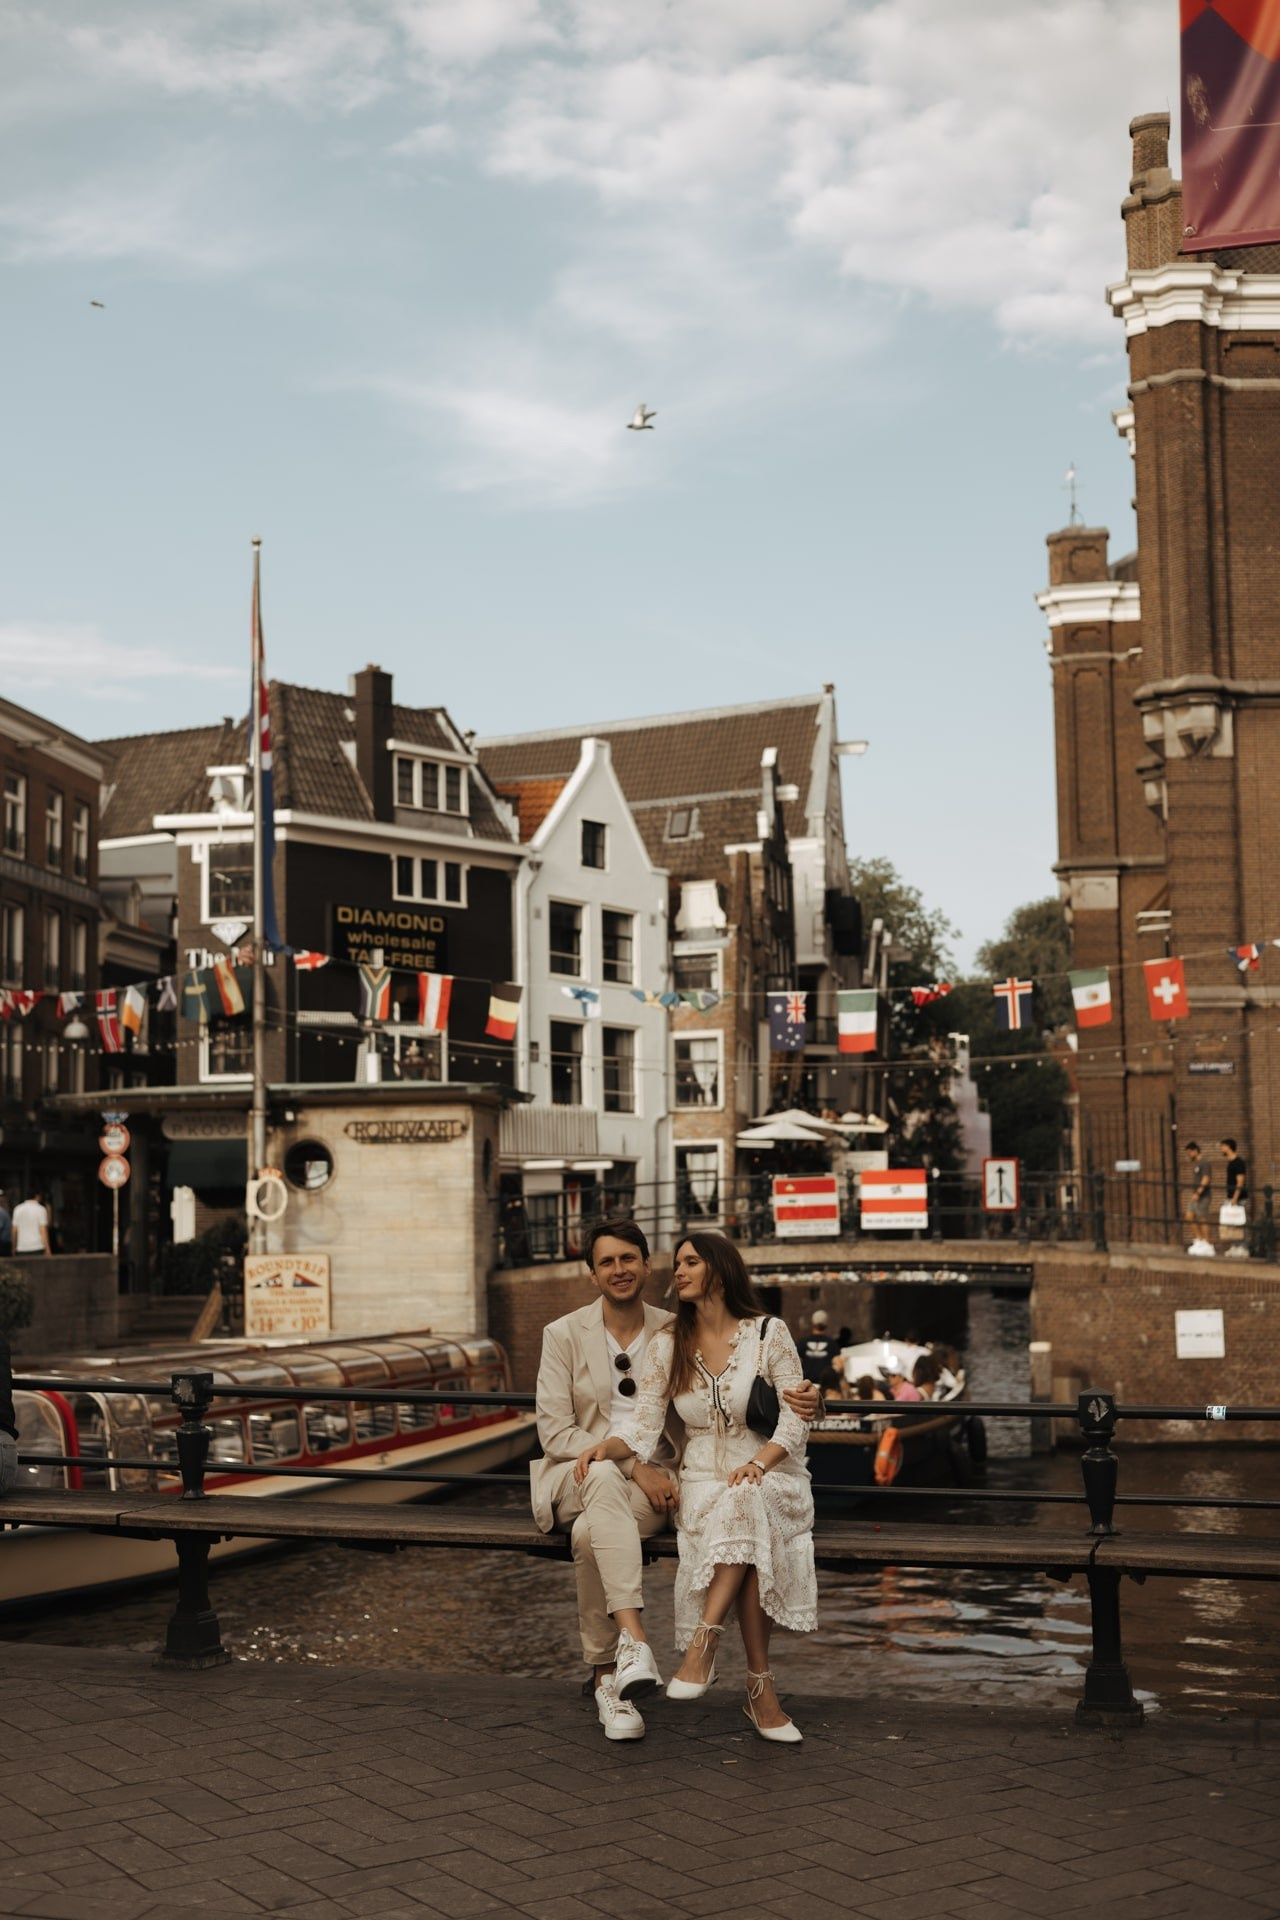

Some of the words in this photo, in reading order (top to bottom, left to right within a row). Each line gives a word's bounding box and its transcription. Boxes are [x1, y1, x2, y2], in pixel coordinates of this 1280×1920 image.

[337, 906, 444, 932] DIAMOND
[346, 929, 437, 951] wholesale
[347, 948, 436, 969] TA-FREE
[354, 1120, 457, 1138] RONDVAART
[247, 1260, 325, 1278] ROUNDTRIP
